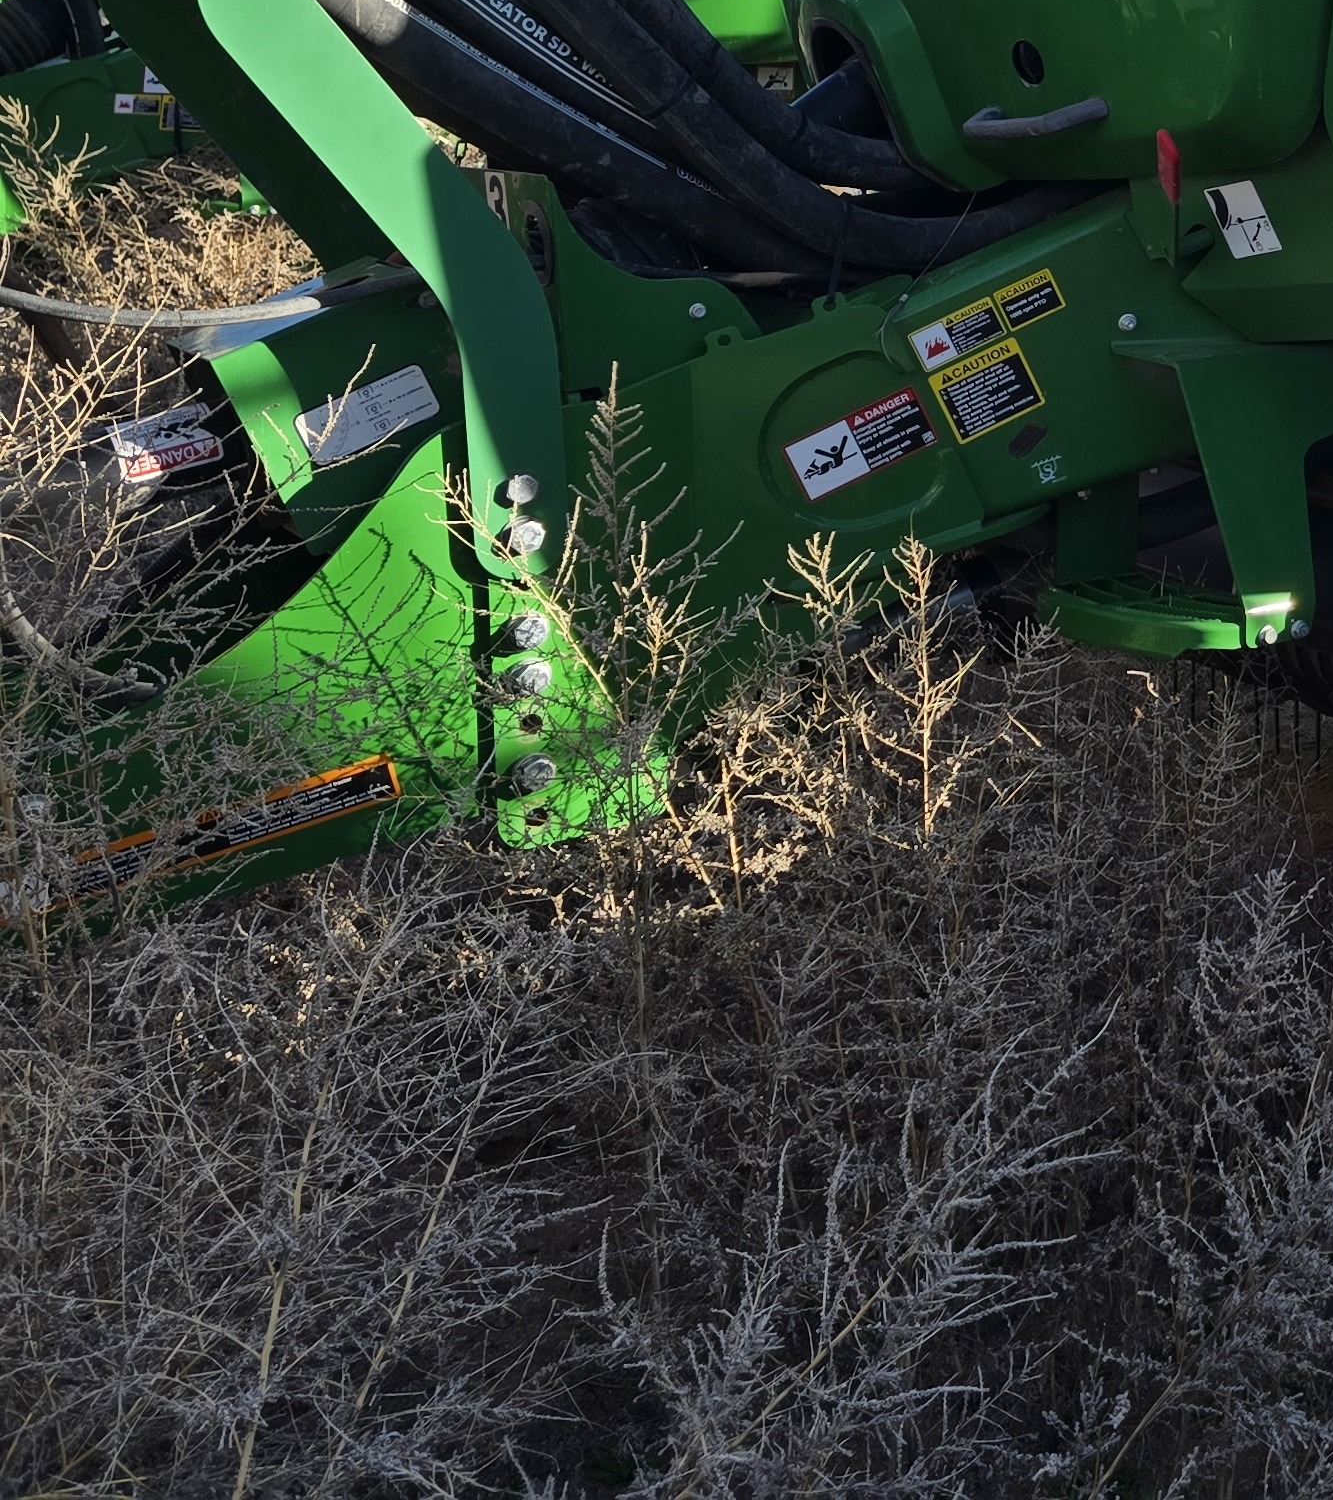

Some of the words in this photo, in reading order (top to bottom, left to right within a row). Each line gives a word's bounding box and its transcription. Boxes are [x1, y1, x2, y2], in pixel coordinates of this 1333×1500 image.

[548, 35, 572, 58] SD
[1006, 274, 1048, 298] CAUTION
[954, 300, 990, 321] CAUTION
[952, 344, 1011, 379] CAUTION
[863, 391, 910, 421] DANGER
[126, 444, 196, 476] DANGER
